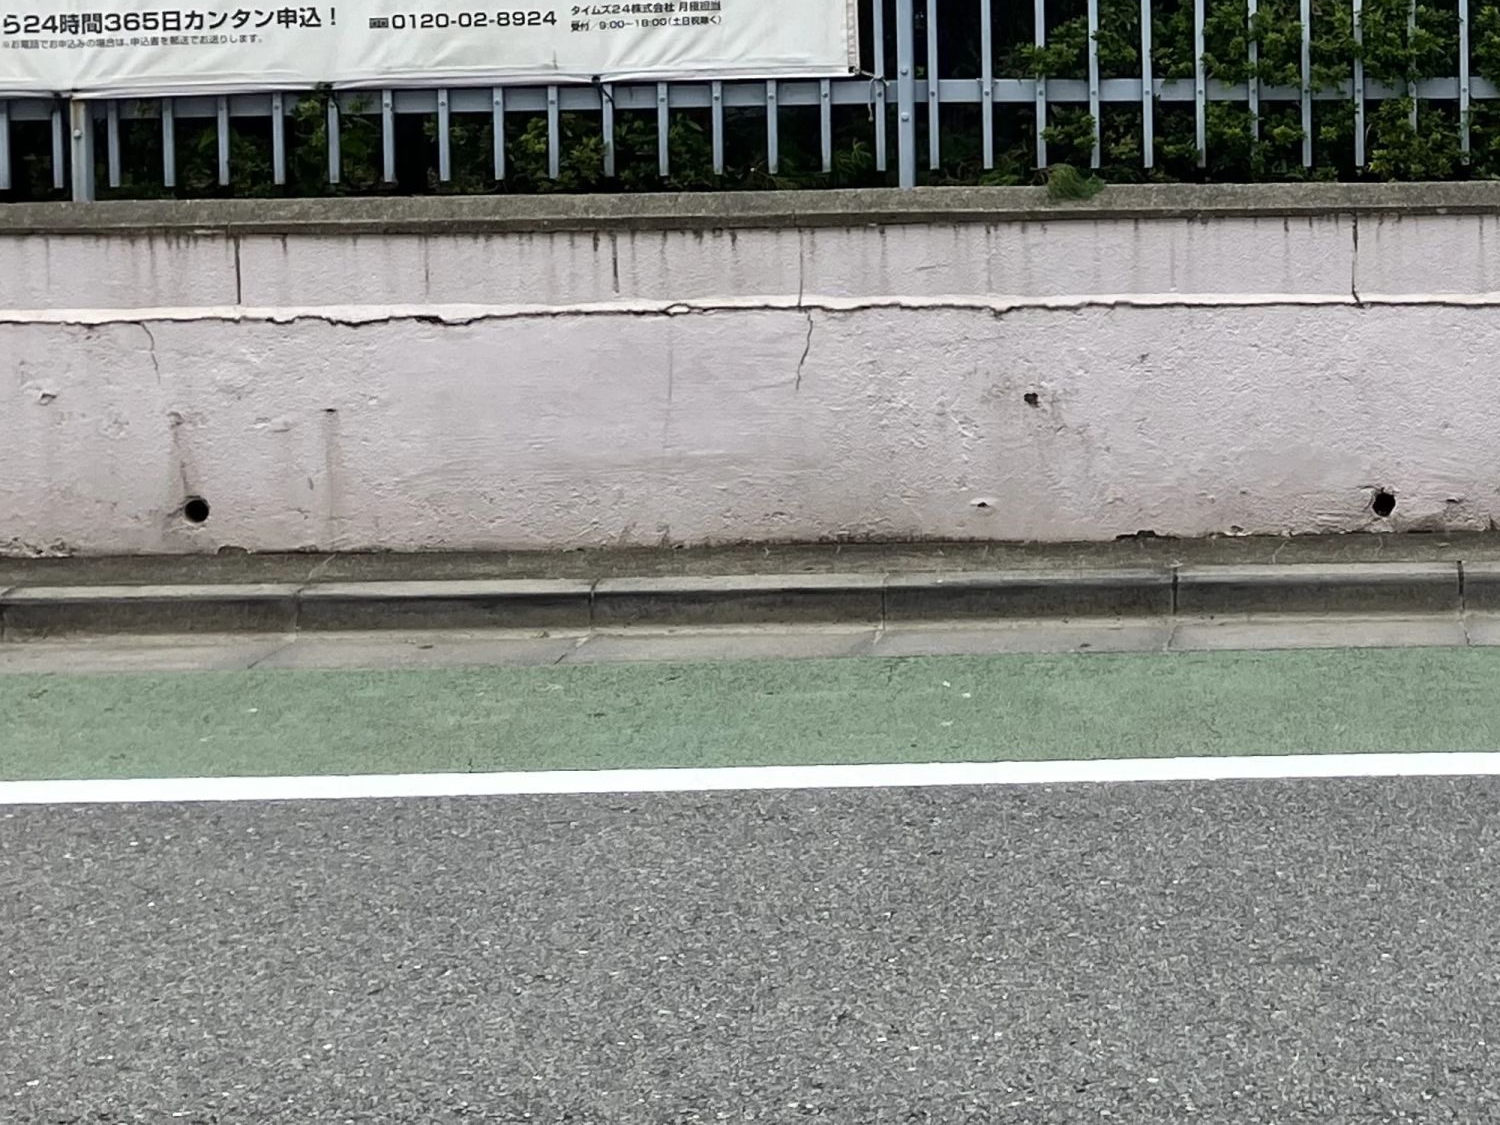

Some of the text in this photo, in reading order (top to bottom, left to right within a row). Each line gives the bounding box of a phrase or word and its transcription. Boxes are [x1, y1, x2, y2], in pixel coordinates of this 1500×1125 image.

[570, 3, 675, 15] タイムズ24株式会社
[391, 11, 558, 29] 0120-02-8924
